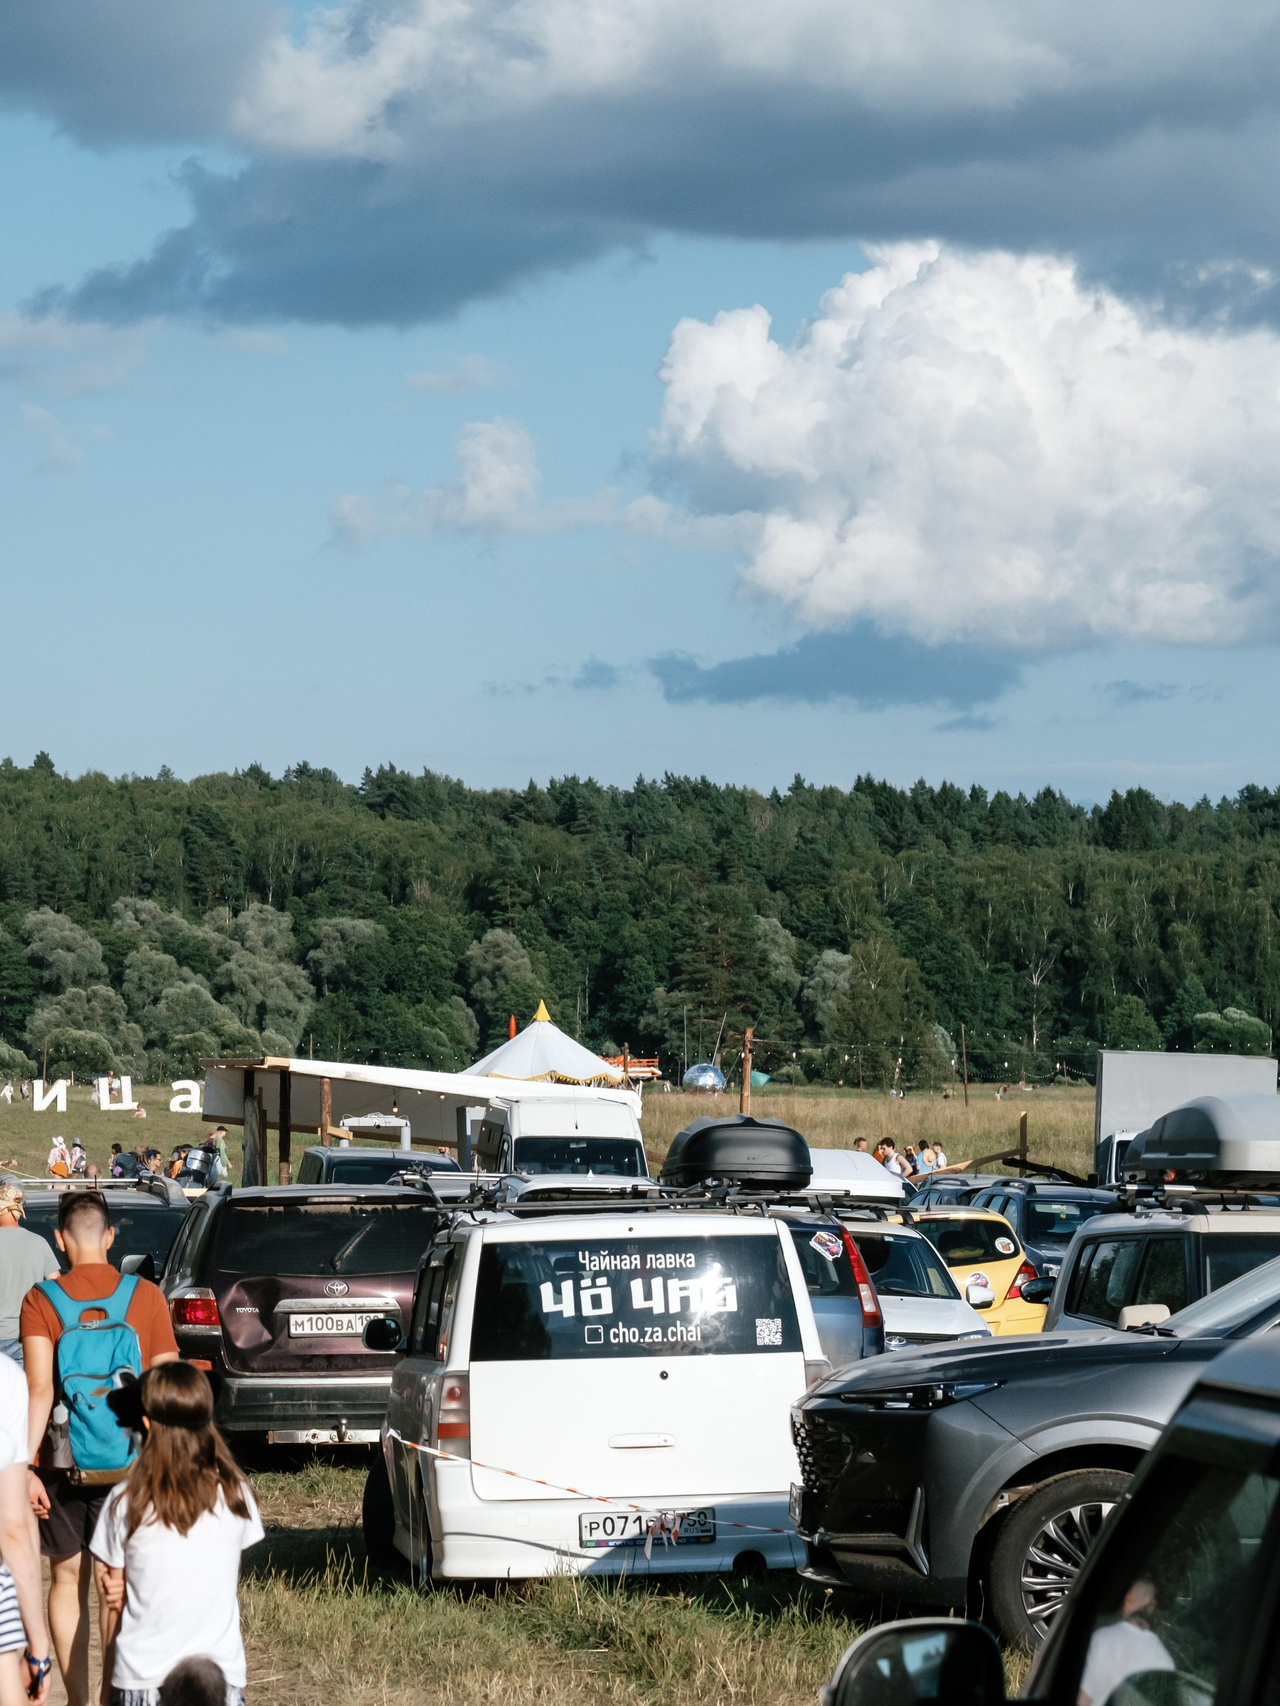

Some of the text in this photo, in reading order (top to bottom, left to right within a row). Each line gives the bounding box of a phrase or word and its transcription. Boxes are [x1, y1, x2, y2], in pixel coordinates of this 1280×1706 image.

[578, 1250, 696, 1271] Чайная лавка
[609, 1321, 702, 1343] cho.za.chai
